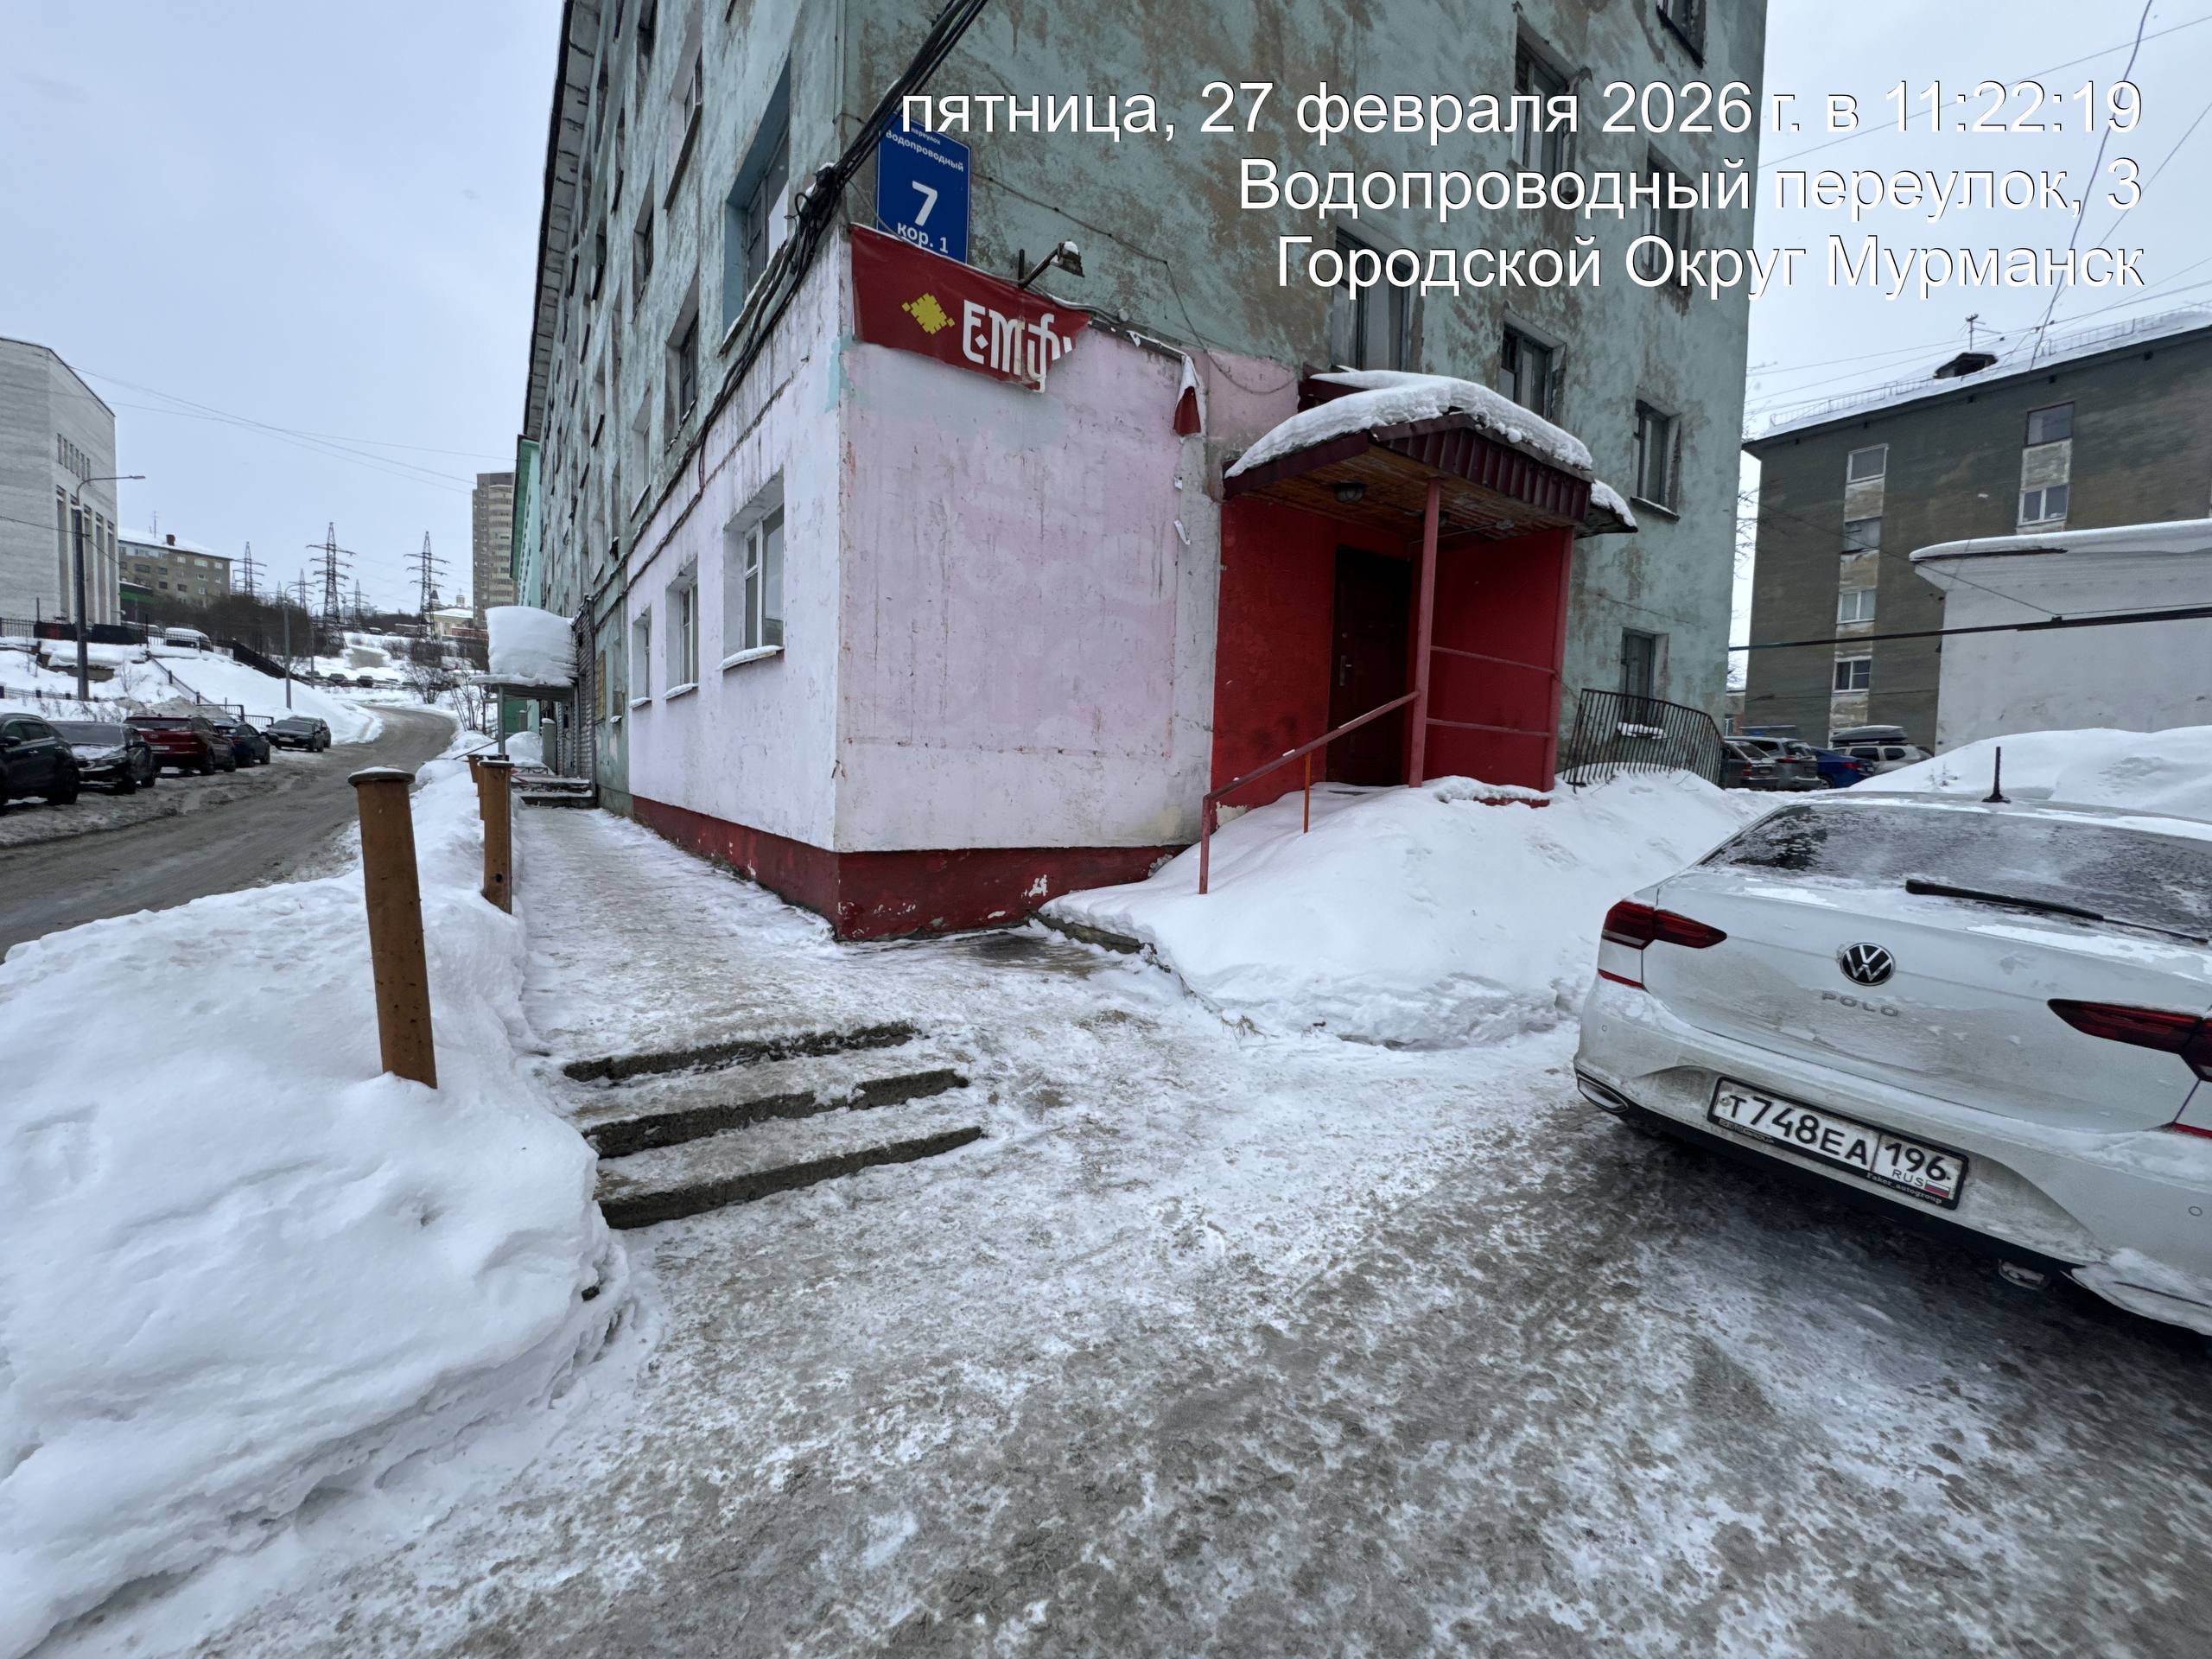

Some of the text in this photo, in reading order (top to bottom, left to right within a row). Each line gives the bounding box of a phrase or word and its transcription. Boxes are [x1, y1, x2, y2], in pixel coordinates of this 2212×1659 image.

[885, 130, 964, 173] Водопроводный
[912, 180, 938, 226] 7
[897, 222, 949, 254] кор. 1
[1821, 990, 1899, 1017] POLO
[1729, 1095, 1868, 1166] Т748ЕА
[1885, 1141, 1947, 1181] 196
[1891, 1168, 1924, 1188] RUS
